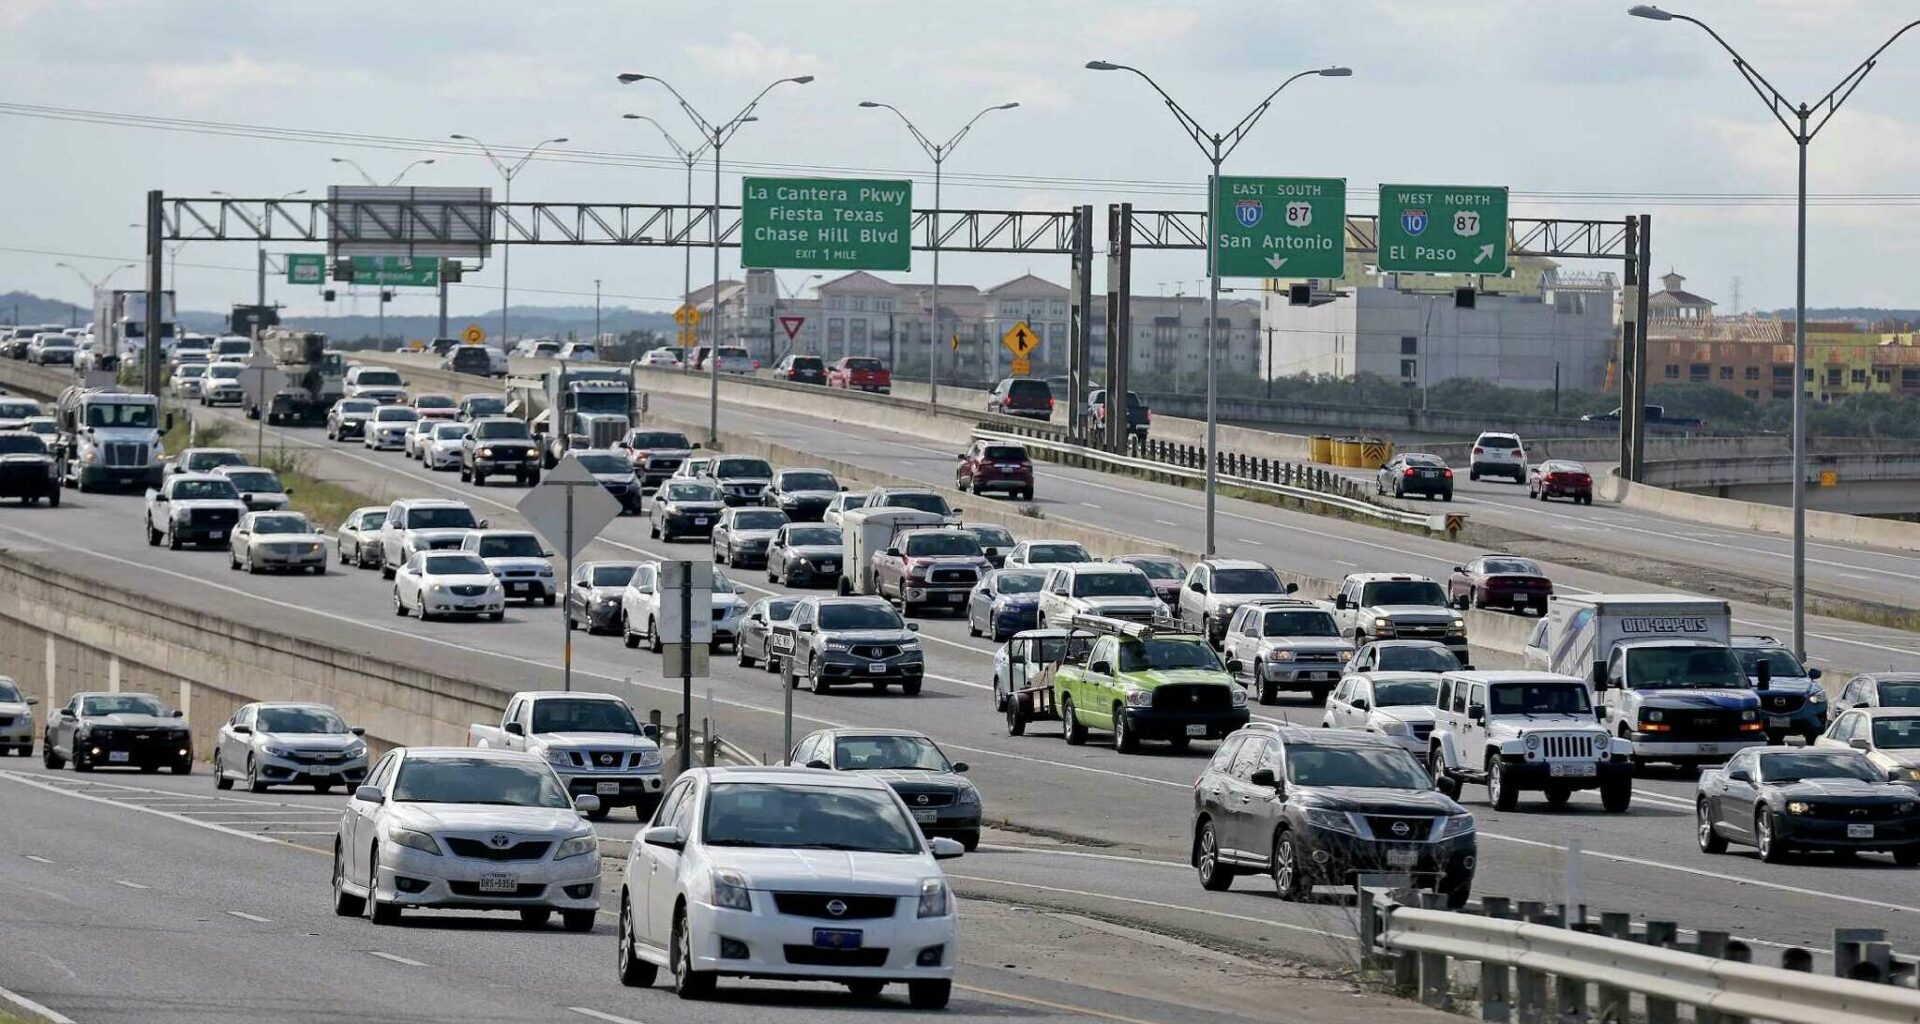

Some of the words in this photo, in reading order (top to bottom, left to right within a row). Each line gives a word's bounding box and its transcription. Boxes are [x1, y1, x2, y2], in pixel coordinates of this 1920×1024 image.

[748, 186, 767, 200] La
[776, 187, 847, 201] Cantera
[860, 188, 905, 206] Pkwy
[1233, 184, 1265, 195] EAST
[1277, 184, 1322, 196] SOUTH
[1398, 193, 1433, 204] WEST
[1445, 194, 1490, 205] NORTH
[770, 206, 823, 221] Fiesta
[833, 208, 884, 222] Texas
[1241, 207, 1257, 222] 10
[1288, 206, 1309, 222] 87
[1407, 216, 1422, 231] 10
[1456, 216, 1477, 231] 87
[754, 227, 808, 241] Chase
[818, 228, 849, 243] Hill
[860, 229, 899, 243] Blvd
[1220, 234, 1251, 248] San
[1262, 234, 1333, 249] Antonio
[796, 250, 816, 259] EXIT
[823, 249, 829, 260] 1
[834, 250, 857, 260] MILE
[1390, 245, 1406, 259] El
[1415, 246, 1456, 260] Paso
